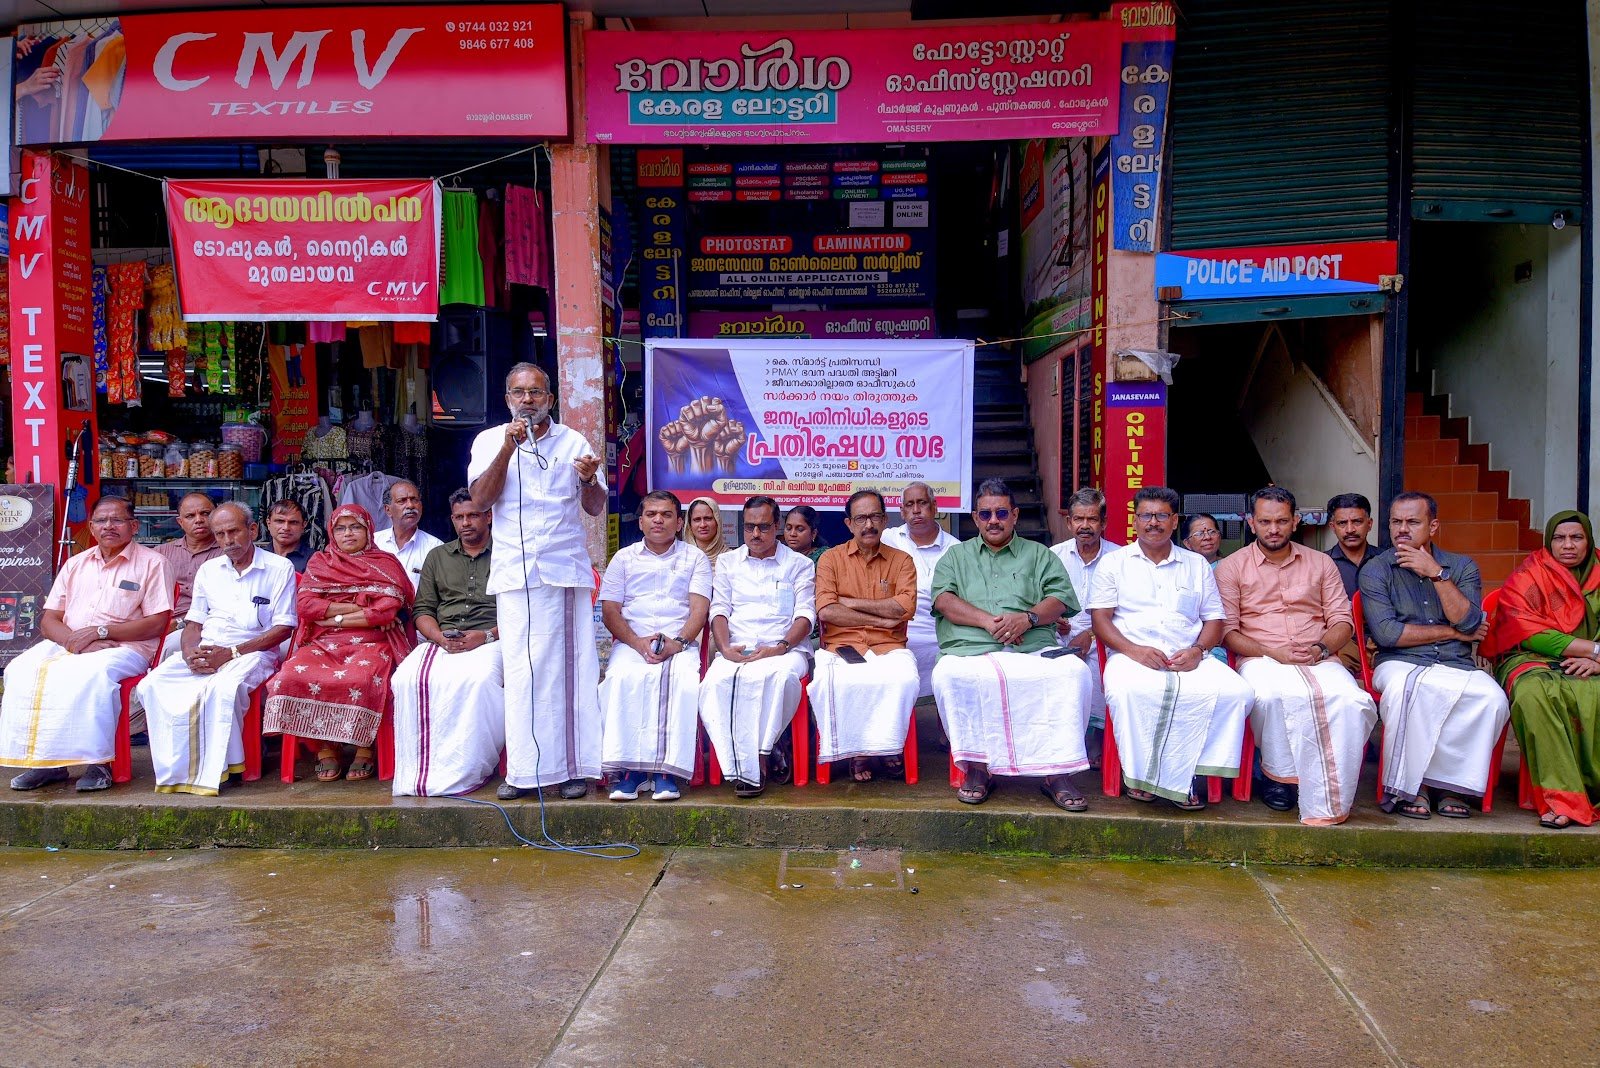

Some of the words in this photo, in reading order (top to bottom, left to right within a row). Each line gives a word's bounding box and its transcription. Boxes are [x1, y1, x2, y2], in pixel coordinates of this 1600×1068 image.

[458, 22, 487, 32] 9744
[489, 21, 510, 32] 032
[512, 20, 533, 31] 921
[459, 39, 487, 50] 9846
[490, 38, 510, 49] 677
[514, 38, 534, 49] 408
[912, 33, 1071, 66] ഫോട്ടോസ്റ്റാറ്റ്
[615, 38, 850, 92] വോൾഗ
[208, 100, 374, 115] TEXTILES
[638, 96, 723, 120] കേരള
[732, 92, 830, 121] ലോട്ടറി
[923, 101, 978, 116] കൂപ്പണുകൾ
[987, 99, 1051, 113] പുസ്തകങ്ങൾ
[1059, 97, 1109, 110] ഫോമുകൾ
[495, 113, 533, 121] OMASSERY
[886, 124, 932, 133] OMASSERY
[183, 190, 422, 229] ആദായവിൽപന
[193, 235, 298, 261] ടോപ്പുകൾ,
[306, 235, 408, 263] നൈറ്റികൾ
[707, 239, 787, 251] PHOTOSTAT
[818, 236, 905, 250] LAMINATION
[691, 257, 764, 272] ജനസേവന
[769, 254, 858, 271] ഓൺലൈൻ
[1094, 183, 1106, 347] ONLINE
[1186, 258, 1254, 285] POLICE
[1261, 257, 1291, 283] AID
[1295, 254, 1343, 282] POST
[248, 265, 355, 287] മുതലായവ
[726, 275, 747, 283] ALL
[751, 275, 793, 283] ONLINE
[797, 273, 881, 282] APPLICATIONS
[825, 318, 872, 333] ഓഫീസ്
[828, 357, 881, 368] പ്രതിസന്ധി
[772, 368, 798, 377] PMAY
[801, 369, 825, 377] ഭവന
[827, 368, 859, 378] പദ്ധതി
[862, 368, 897, 378] അട്ടിമറി
[771, 378, 854, 389] ജീവനക്കാരില്ലാതെ
[856, 378, 916, 389] ഓഫീസുകൾ
[763, 391, 817, 401] സർക്കാർ
[820, 392, 849, 401] നയം
[853, 391, 918, 403] തിരുത്തുക
[1111, 393, 1160, 401] JANASEVANA
[763, 407, 929, 430] ജനപ്രതിനിധികളുടെ
[748, 428, 887, 464] പ്രതിഷേധ
[895, 434, 945, 459] സഭ
[1126, 412, 1145, 489] ONLINE
[822, 463, 848, 471] ജൂലൈ
[849, 461, 857, 469] 3
[859, 463, 880, 471] വ്യാഴം
[881, 462, 903, 470] 10.30
[866, 471, 894, 479] ഓഫീസ്
[788, 482, 816, 491] ചെറിയ
[818, 481, 852, 493] മുഹമ്മദ്
